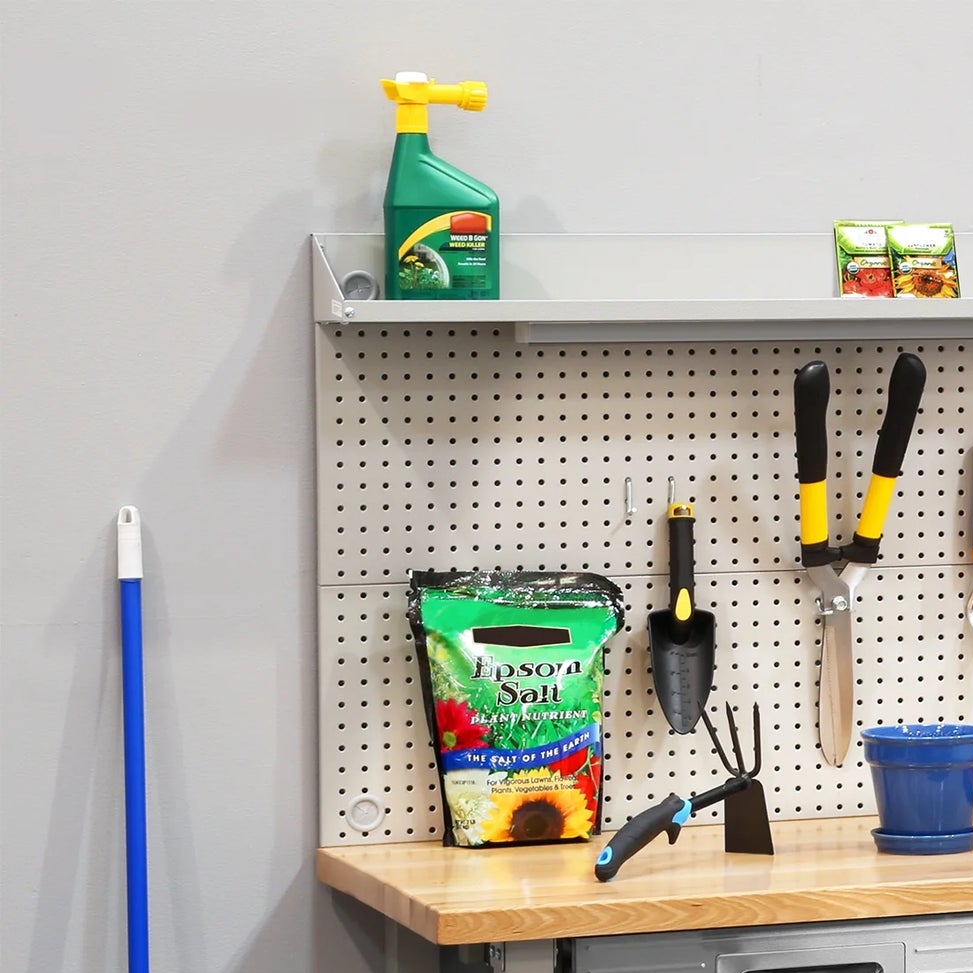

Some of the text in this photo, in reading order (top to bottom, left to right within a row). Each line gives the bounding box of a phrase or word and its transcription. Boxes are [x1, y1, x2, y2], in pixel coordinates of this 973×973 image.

[471, 655, 583, 682] Epsom
[497, 681, 563, 706] Salt
[470, 709, 588, 725] PLANT NUTRIENT
[466, 732, 590, 763] THE SALT OF THE EARTH
[498, 777, 530, 787] Vigorous
[515, 784, 554, 794] Vegetables
